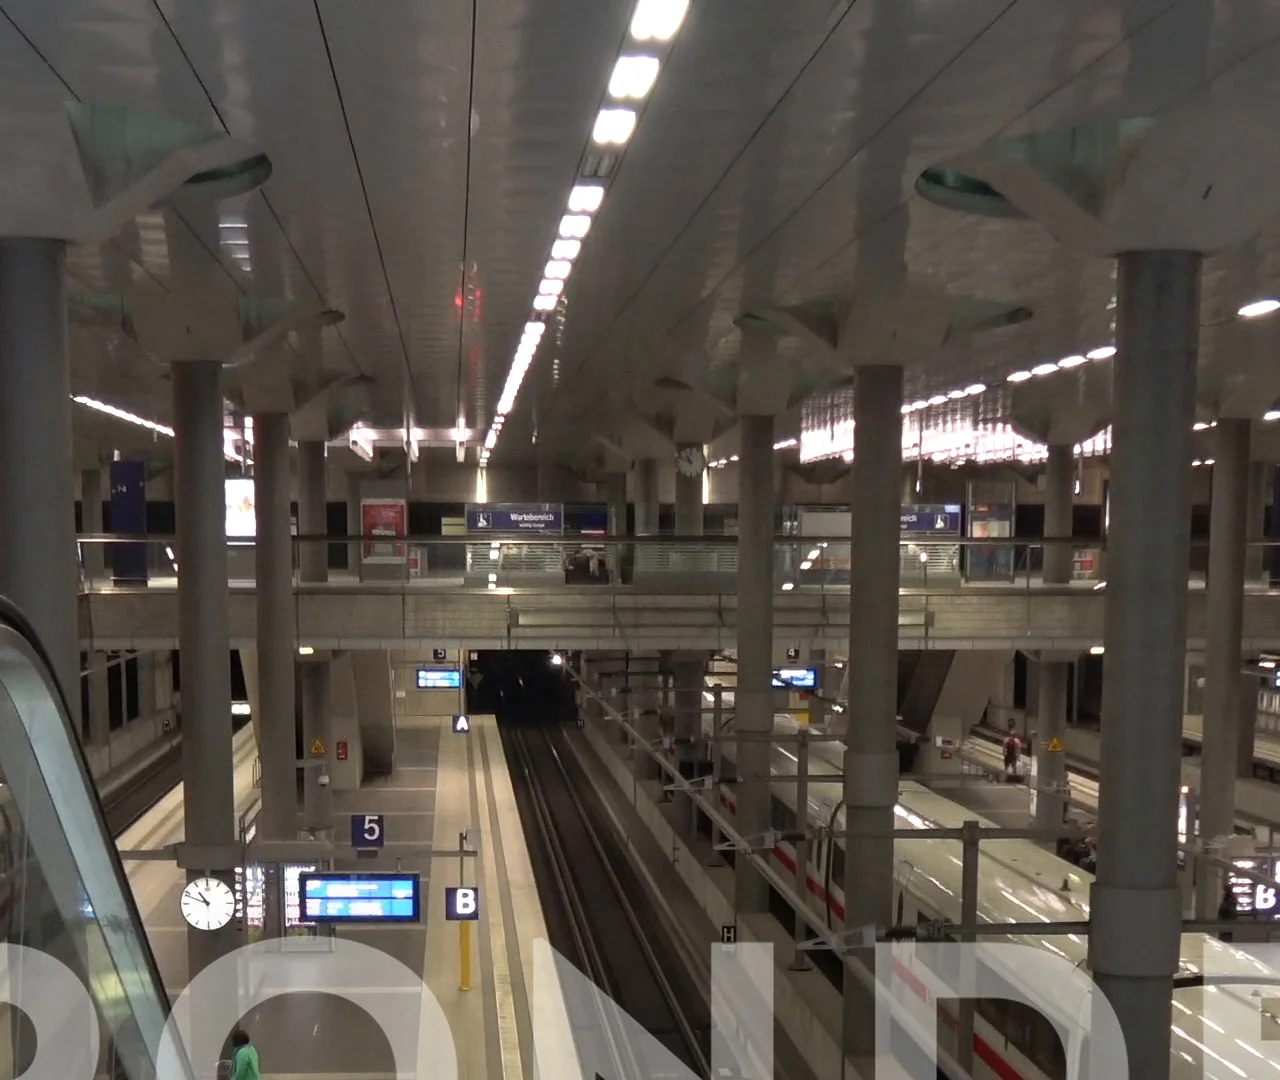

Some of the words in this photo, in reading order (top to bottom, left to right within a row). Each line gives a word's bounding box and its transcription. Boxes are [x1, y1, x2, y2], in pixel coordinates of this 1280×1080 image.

[788, 648, 795, 657] 4
[456, 715, 469, 731] A
[363, 815, 380, 841] 5
[456, 888, 476, 914] B
[1255, 884, 1276, 909] B
[723, 927, 734, 942] H
